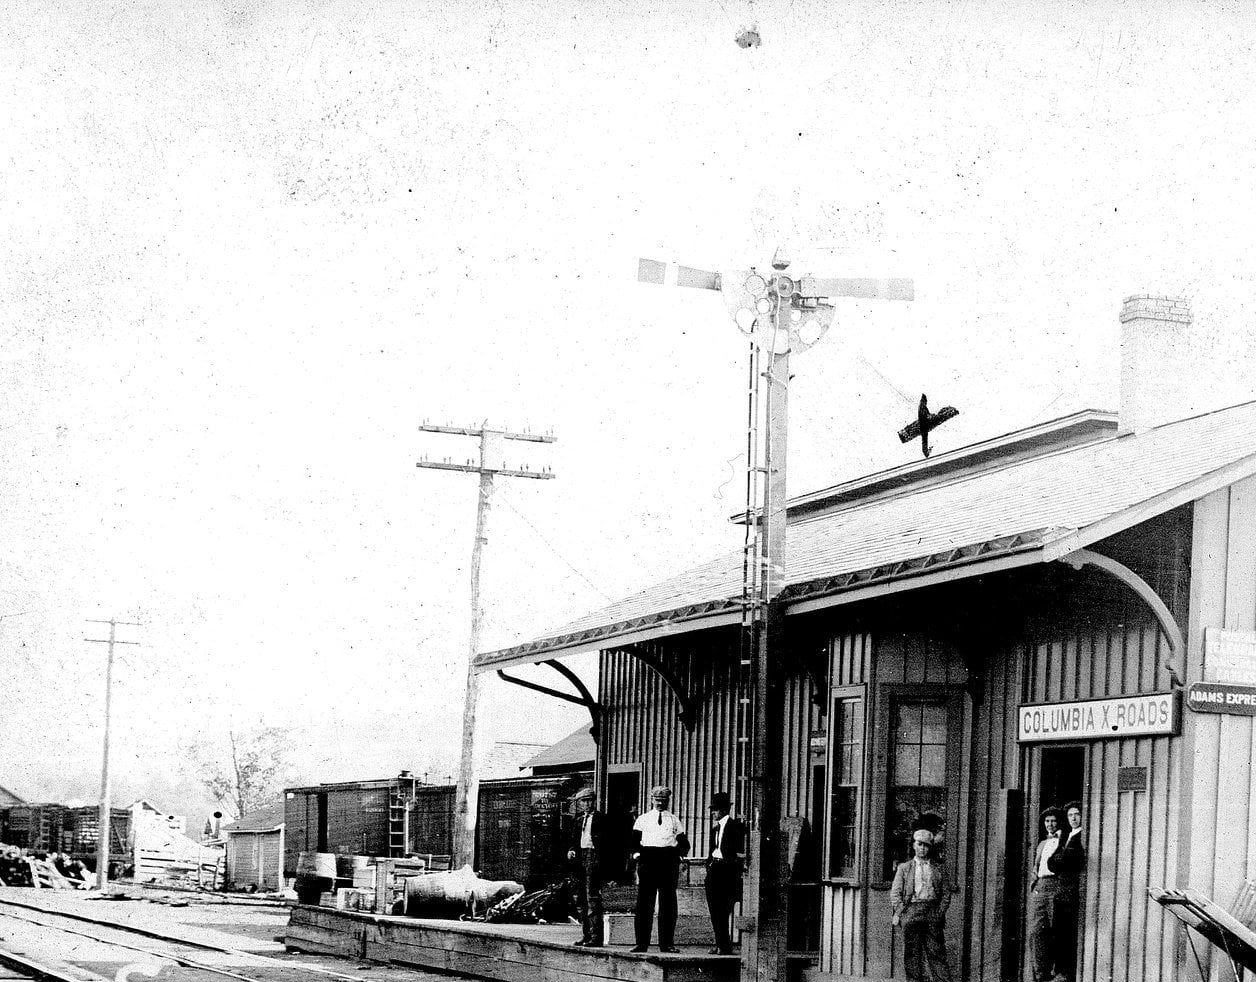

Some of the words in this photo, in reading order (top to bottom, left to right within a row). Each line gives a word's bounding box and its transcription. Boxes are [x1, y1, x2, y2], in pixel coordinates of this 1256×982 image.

[1190, 689, 1224, 705] ADAMS
[1023, 703, 1095, 735] COLUMBIA
[1101, 702, 1110, 728] X
[1116, 699, 1170, 728] ROADS
